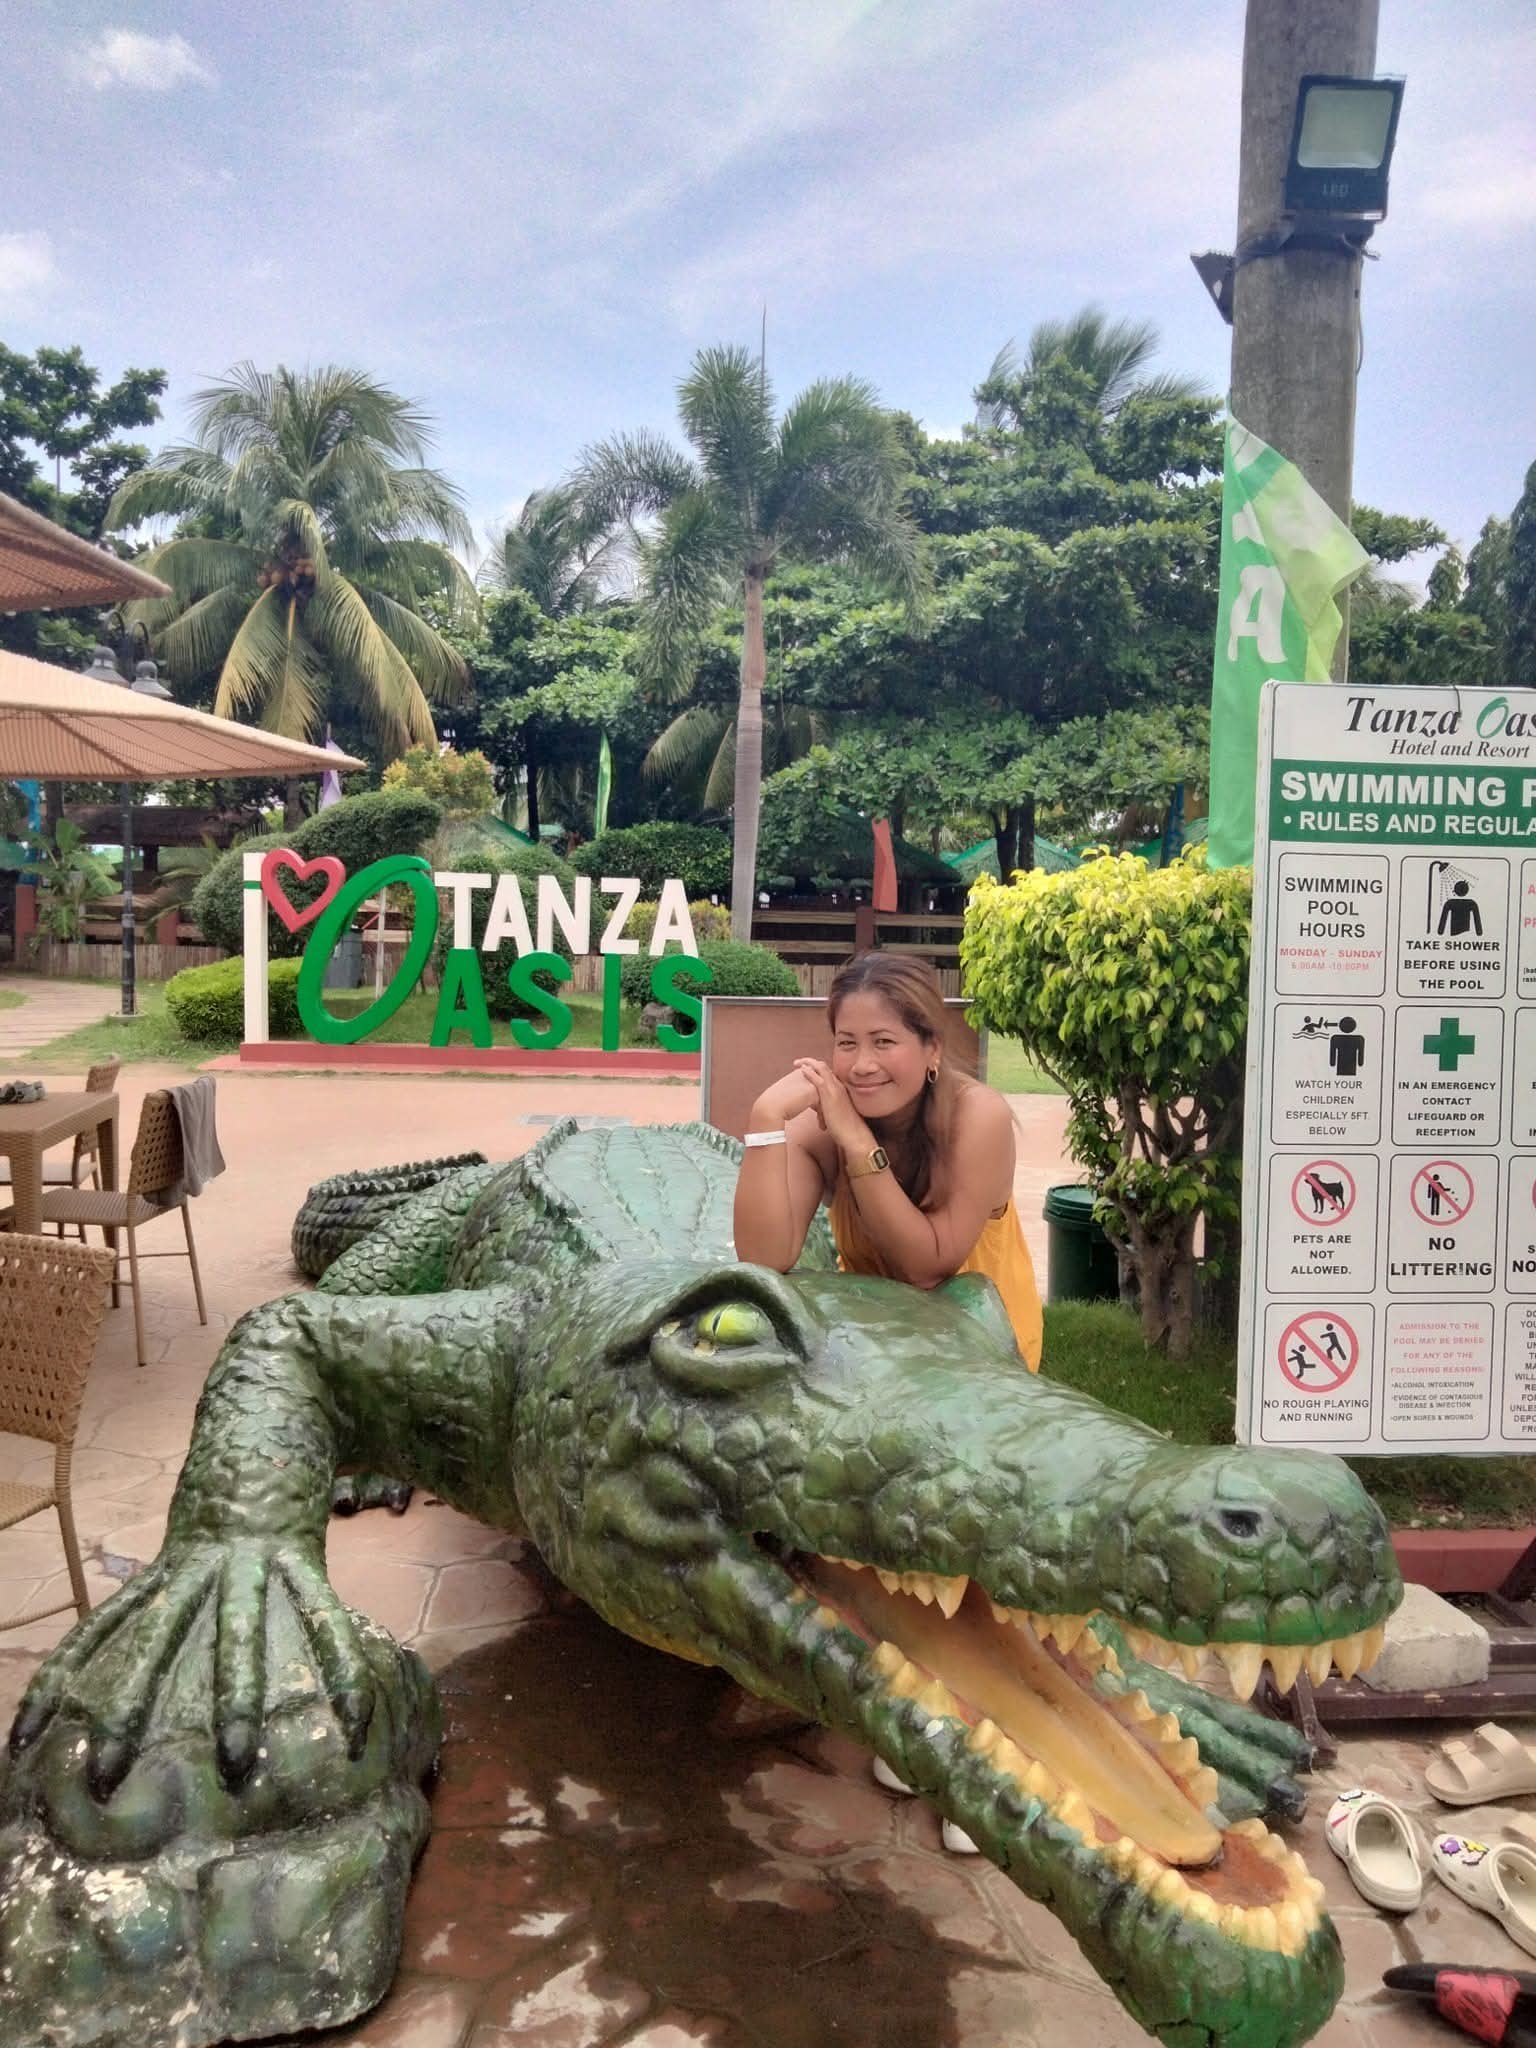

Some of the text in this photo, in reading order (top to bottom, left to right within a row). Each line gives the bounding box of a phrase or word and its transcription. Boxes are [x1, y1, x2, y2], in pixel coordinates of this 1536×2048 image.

[1345, 697, 1462, 738] Tanza
[1389, 739, 1530, 758] Hotel and Resort
[1281, 771, 1507, 807] SWIMMING
[1300, 811, 1379, 832] RULES
[1386, 815, 1437, 833] AND
[1285, 877, 1383, 894] SWIMMING
[1308, 900, 1359, 916] POOL
[1300, 922, 1366, 938] HOURS
[243, 853, 700, 1043] I TANZA
[1406, 940, 1500, 951] TAKE SHOWER
[1280, 948, 1327, 957] MONDAY
[1338, 949, 1383, 959] SUNDAY
[1404, 960, 1501, 971] BEFORE USING
[1419, 979, 1484, 990] THE POOL
[1295, 1080, 1363, 1089] WATCH YOUR
[1431, 1082, 1496, 1090] EMERGENCY
[1303, 1096, 1354, 1104] CHILDREN
[1286, 1111, 1368, 1120] ESPECIALLY 5FT
[1408, 1113, 1485, 1121] LIFEGUARD OR
[1309, 1126, 1346, 1135] BELOW
[1416, 1128, 1475, 1136] RECEPTION
[1293, 1235, 1352, 1244] PETS ARE
[1429, 1237, 1456, 1250] NO
[1310, 1250, 1335, 1259] NOT
[1291, 1266, 1351, 1275] ALLOWED.
[1391, 1262, 1493, 1276] LITTERING
[1394, 1337, 1485, 1345] POOL MAY BE DENIED
[1403, 1352, 1420, 1360] FOR
[1391, 1366, 1440, 1374] FOLLOWING
[1264, 1400, 1369, 1408] NO ROUGH PLAYING
[1280, 1413, 1353, 1421] AND RUNNING
